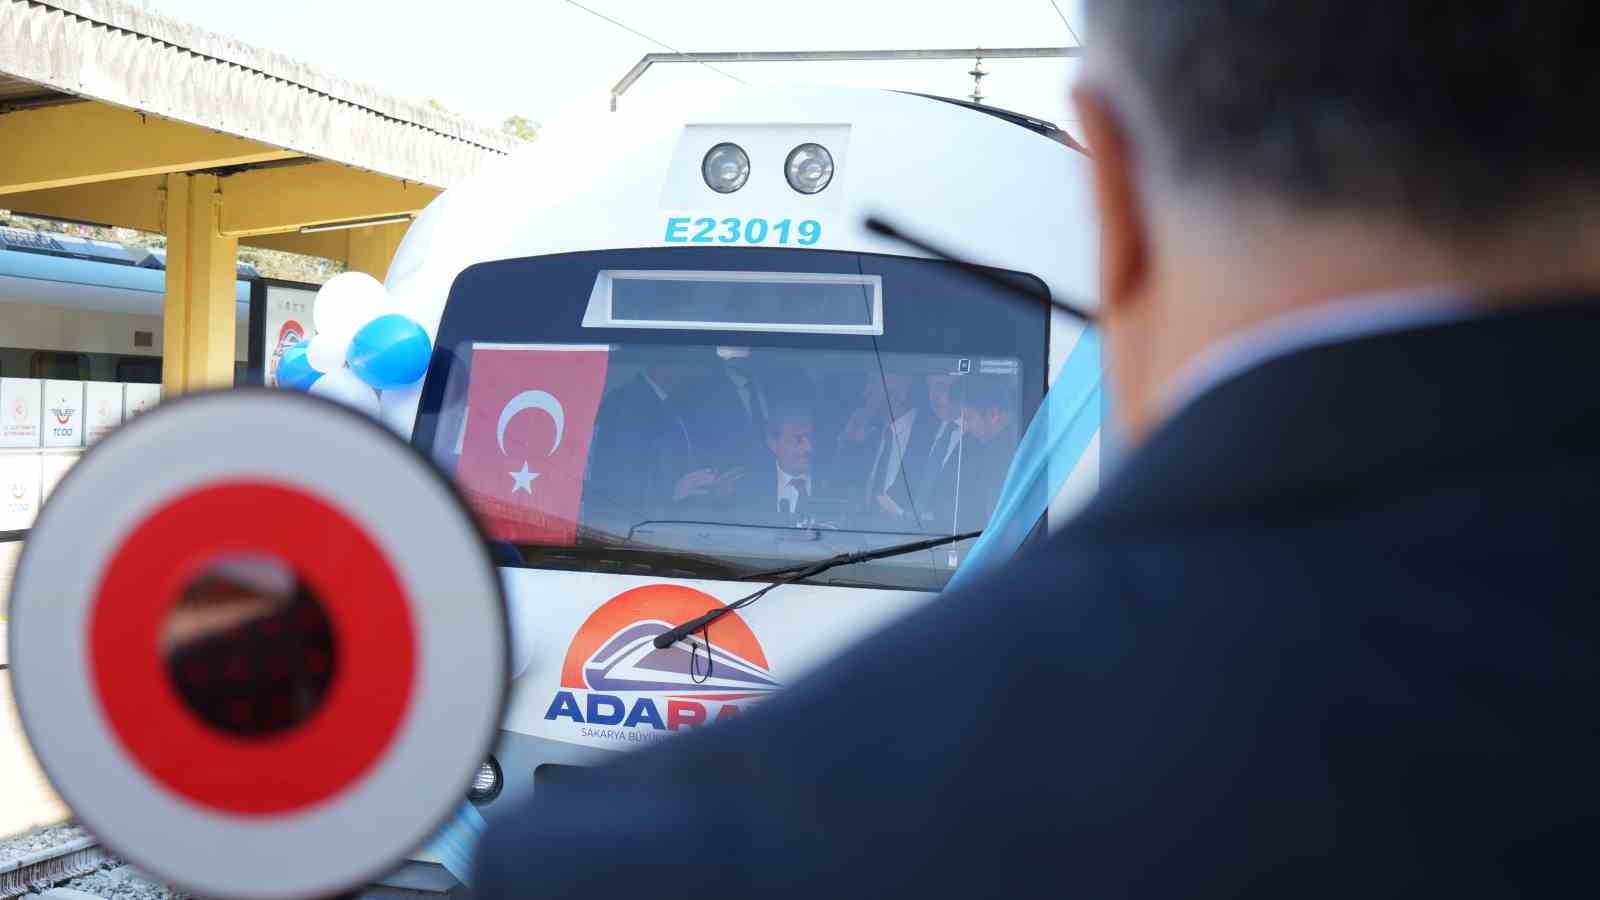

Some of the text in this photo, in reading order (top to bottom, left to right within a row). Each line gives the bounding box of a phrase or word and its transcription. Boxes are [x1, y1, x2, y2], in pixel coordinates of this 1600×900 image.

[664, 217, 822, 246] E23019
[544, 691, 748, 730] ADARA
[581, 727, 626, 741] SAKARYA
